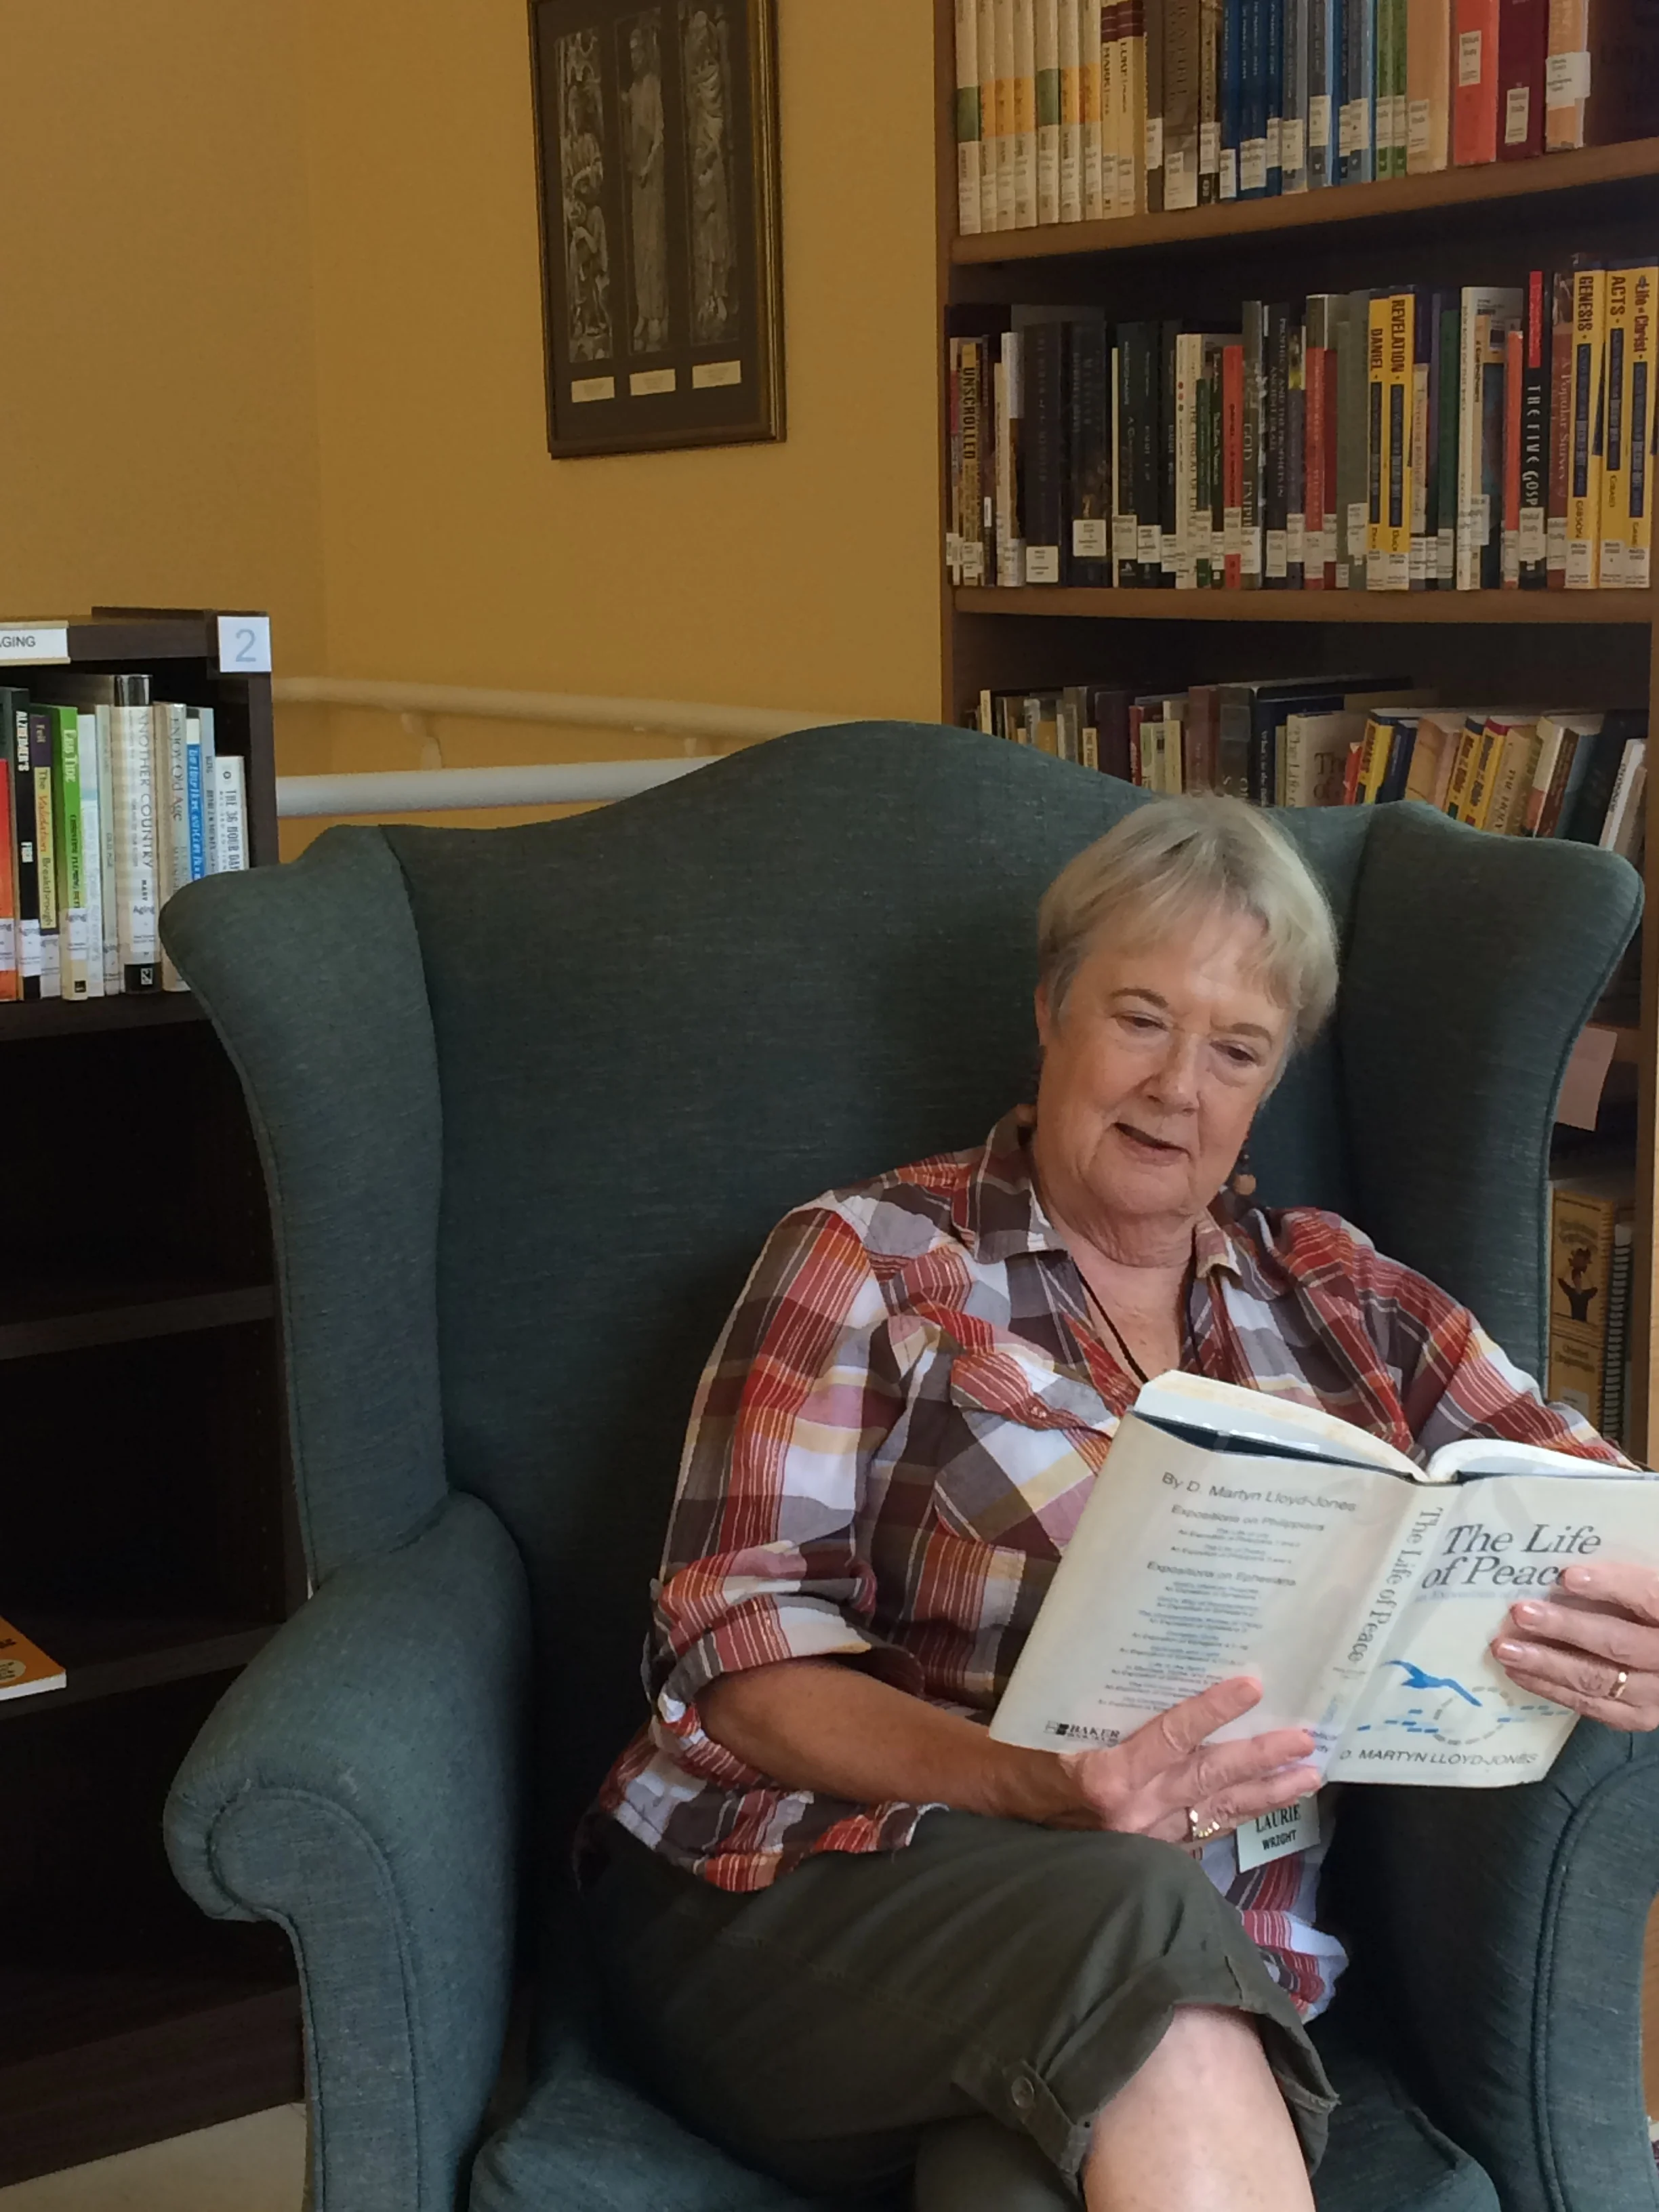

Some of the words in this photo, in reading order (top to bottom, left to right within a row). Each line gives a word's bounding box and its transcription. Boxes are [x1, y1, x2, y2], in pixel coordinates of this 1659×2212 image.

[1578, 276, 1594, 331] GENESIS
[1610, 276, 1626, 316] ACTS
[1371, 328, 1383, 371] DANIEL
[1391, 300, 1406, 373] REVELATION
[1634, 315, 1650, 352] Christ
[963, 367, 976, 459] UNSCROLLED
[1525, 385, 1541, 416] THE
[1558, 372, 1570, 428] Popular
[1525, 424, 1541, 464] FIVE
[1522, 470, 1540, 506] GOSP
[0, 636, 35, 648] GING
[235, 628, 256, 662] 2
[17, 711, 30, 771] ALZHEIMER'S
[138, 710, 151, 786] ANOTHER
[169, 718, 183, 761] ENJOY
[38, 769, 49, 790] The
[171, 764, 184, 791] Old
[171, 796, 184, 822] Age
[224, 790, 237, 806] THE
[38, 794, 52, 852] Validation
[141, 793, 154, 869] COUNTRY
[226, 811, 238, 823] 36
[227, 826, 239, 852] HOUR
[41, 857, 55, 926] Breakthrough
[1162, 1471, 1184, 1489] By
[1208, 1485, 1262, 1502] Martyn
[1406, 1507, 1444, 1544] The
[1442, 1523, 1514, 1555] The
[1519, 1523, 1602, 1555] Life
[1386, 1549, 1422, 1585] Life
[1420, 1555, 1468, 1589] of
[1376, 1588, 1397, 1613] of
[1347, 1610, 1392, 1662] Peace
[1358, 1749, 1427, 1763] MARTYN
[1255, 1803, 1302, 1833] LAURIE
[1261, 1829, 1297, 1851] WRIGHT
